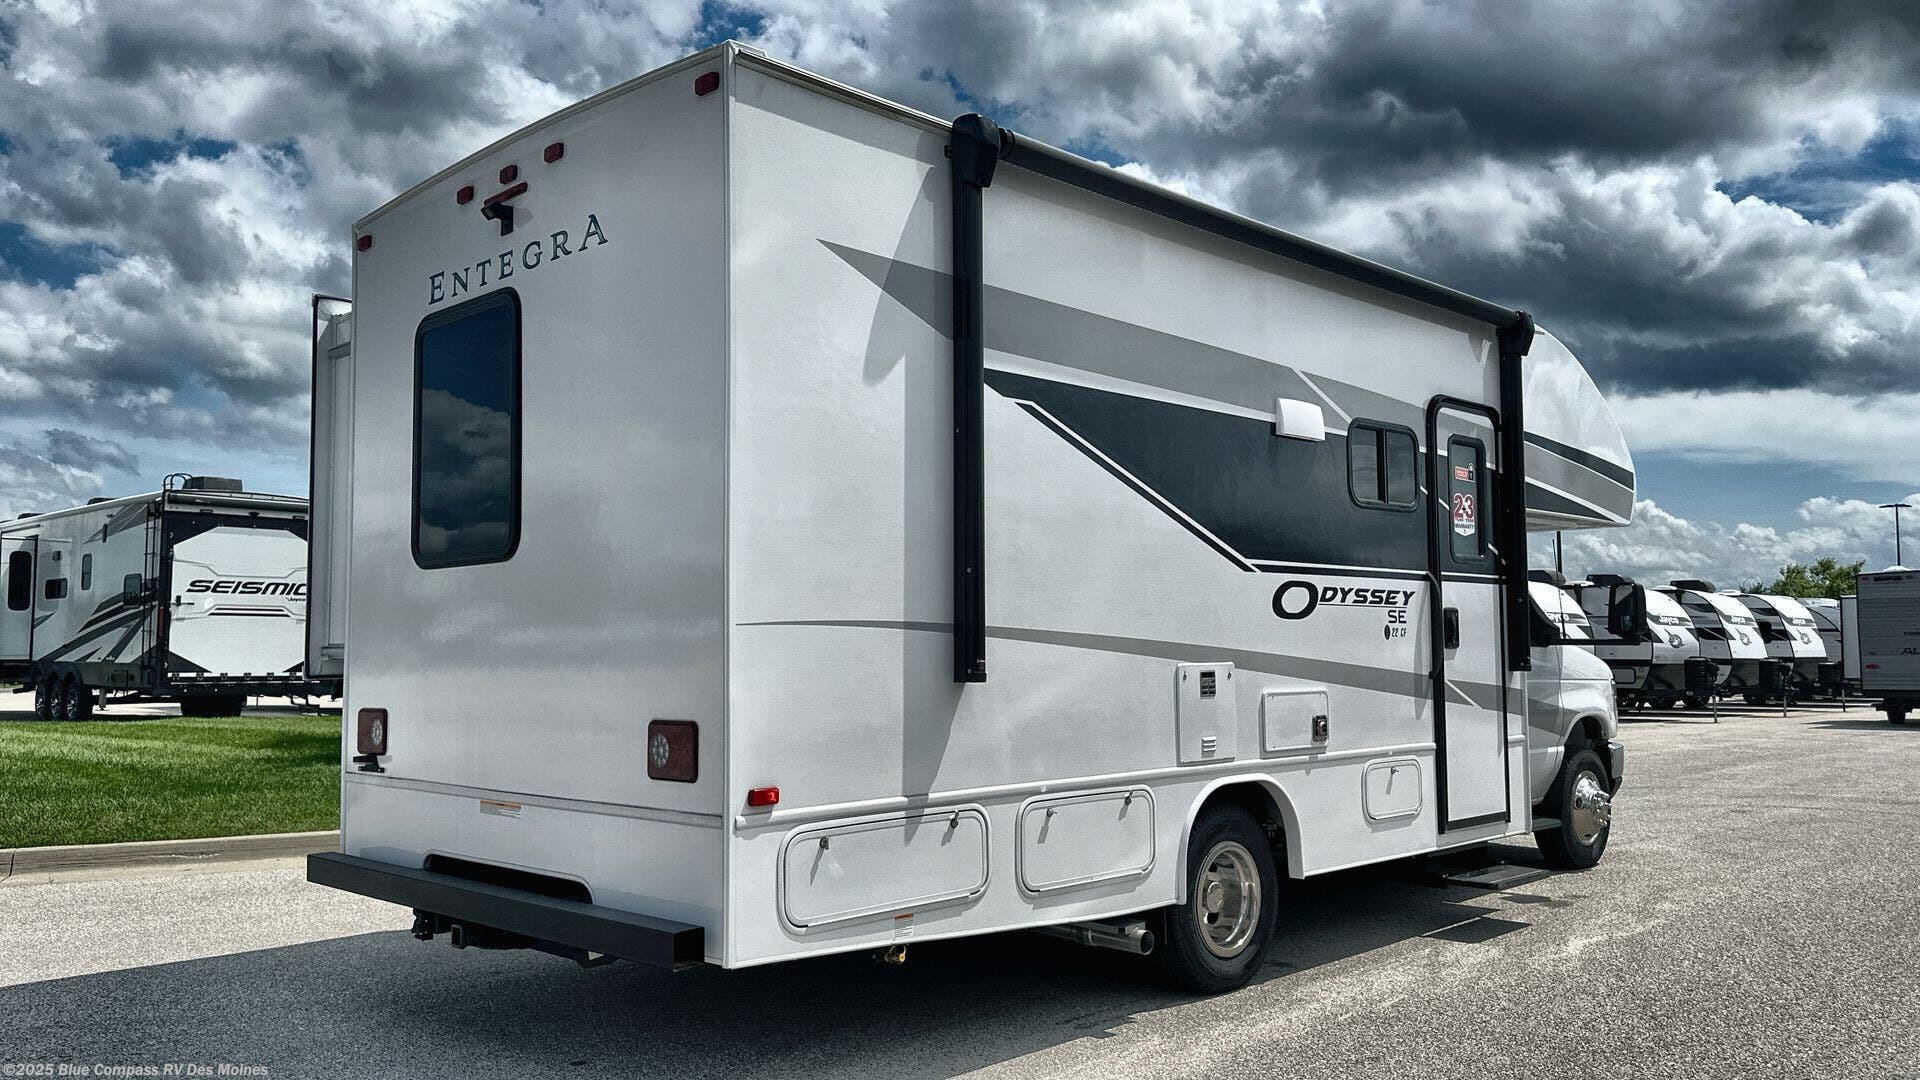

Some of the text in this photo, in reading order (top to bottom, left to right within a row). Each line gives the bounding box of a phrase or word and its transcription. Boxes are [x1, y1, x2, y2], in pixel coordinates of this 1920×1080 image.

[428, 213, 608, 305] ENTEGRA
[1272, 580, 1416, 620] ODYSSEY
[1387, 609, 1407, 624] SE
[1659, 614, 1679, 626] Jayco
[1391, 627, 1399, 637] 22
